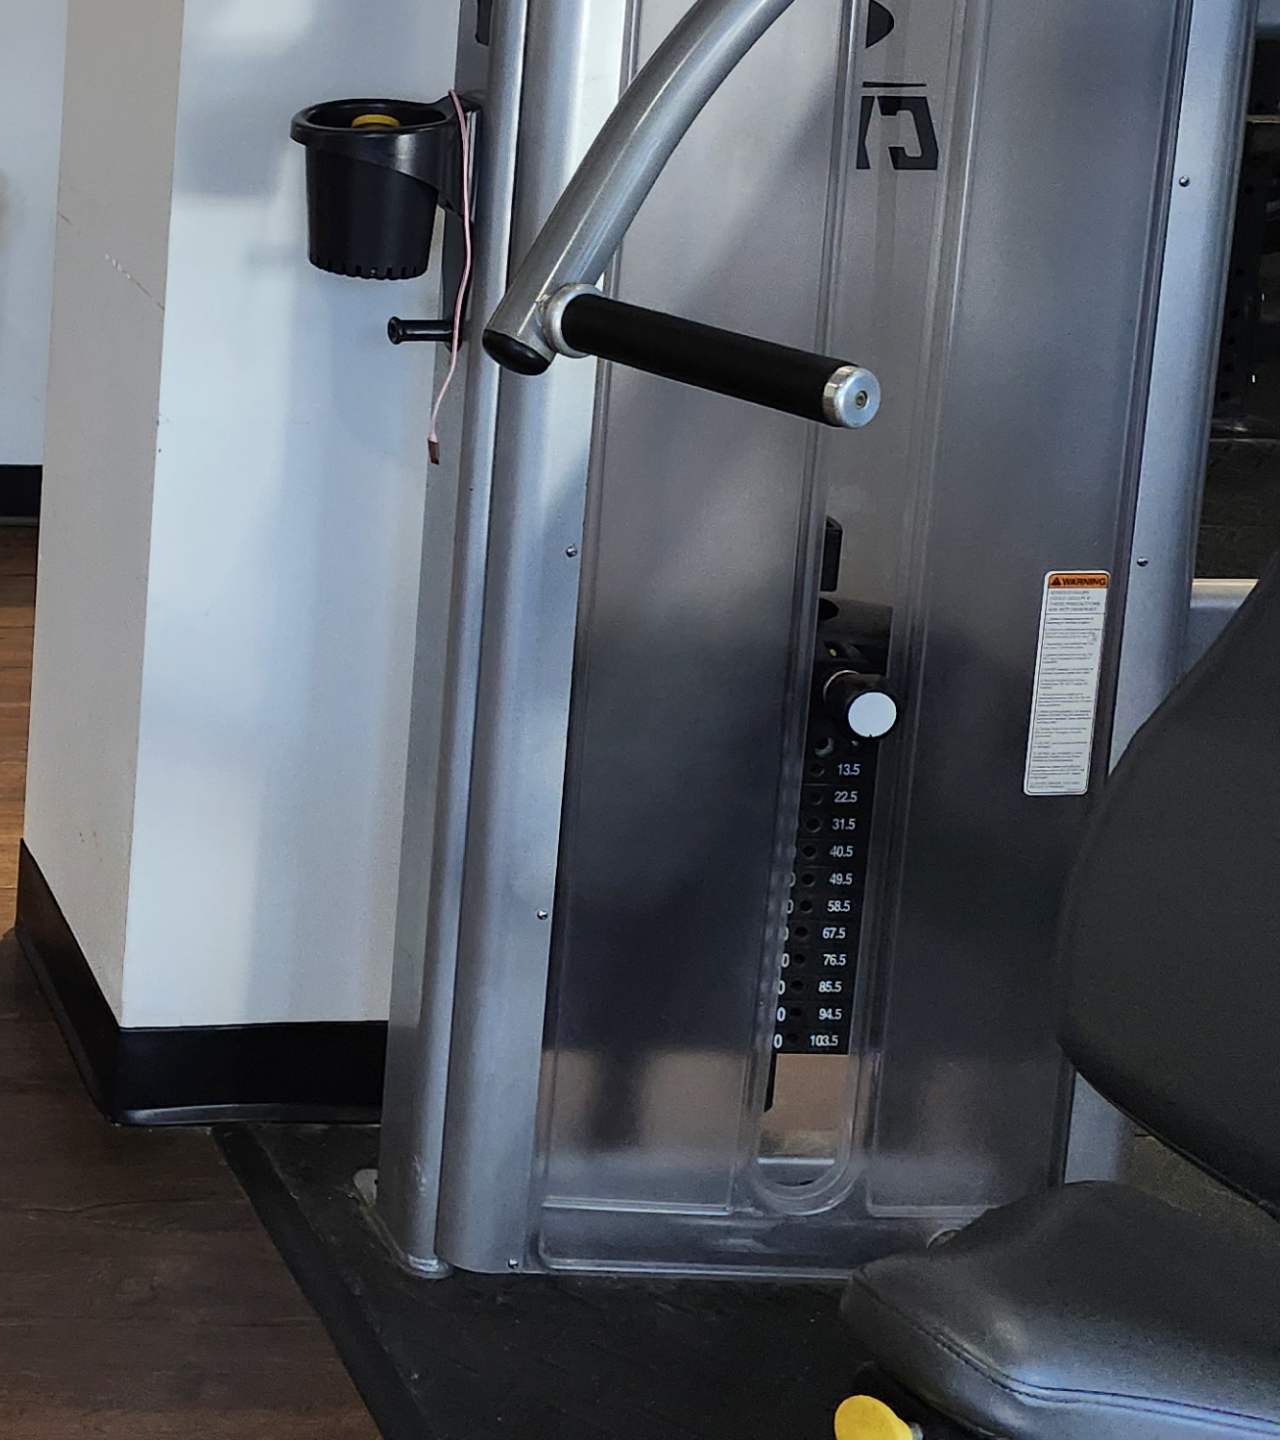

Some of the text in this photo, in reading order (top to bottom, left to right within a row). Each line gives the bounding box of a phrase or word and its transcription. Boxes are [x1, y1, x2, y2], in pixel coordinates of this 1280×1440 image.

[1062, 577, 1106, 586] WARNING
[837, 763, 860, 776] 13.5
[834, 791, 858, 803] 22.5
[832, 818, 856, 831] 31.5
[829, 845, 854, 858] 40.5
[829, 873, 853, 886] 49.5
[827, 900, 851, 913] 58.5
[822, 927, 846, 940] 67.5
[823, 954, 847, 967] 76.5
[818, 981, 842, 993] 85.5
[818, 1008, 842, 1021] 94.5
[810, 1034, 839, 1047] 103.5
